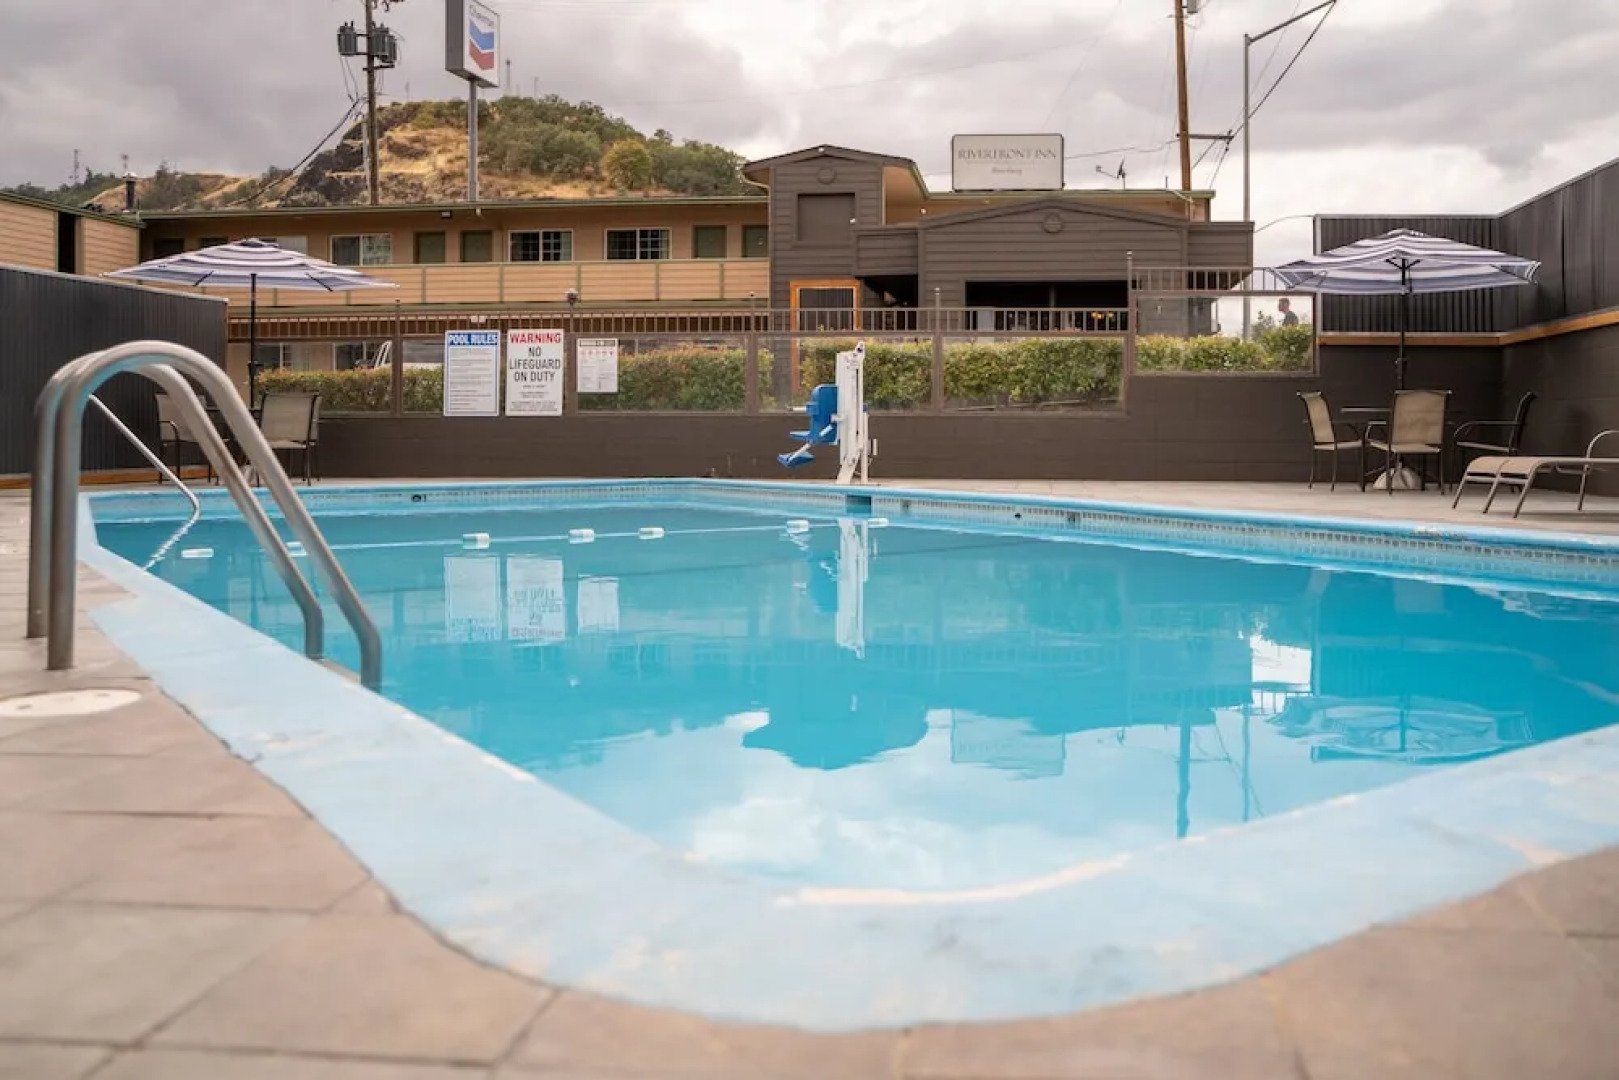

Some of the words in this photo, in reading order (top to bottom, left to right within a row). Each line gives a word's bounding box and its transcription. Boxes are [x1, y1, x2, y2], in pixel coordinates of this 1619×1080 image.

[1035, 148, 1057, 159] INN
[449, 333, 468, 345] POOL
[470, 333, 498, 345] RULES
[509, 332, 561, 344] WARNING
[528, 346, 542, 357] NO
[509, 359, 561, 370] LIFEGUARD
[514, 371, 528, 383] ON
[530, 371, 556, 383] DUTY
